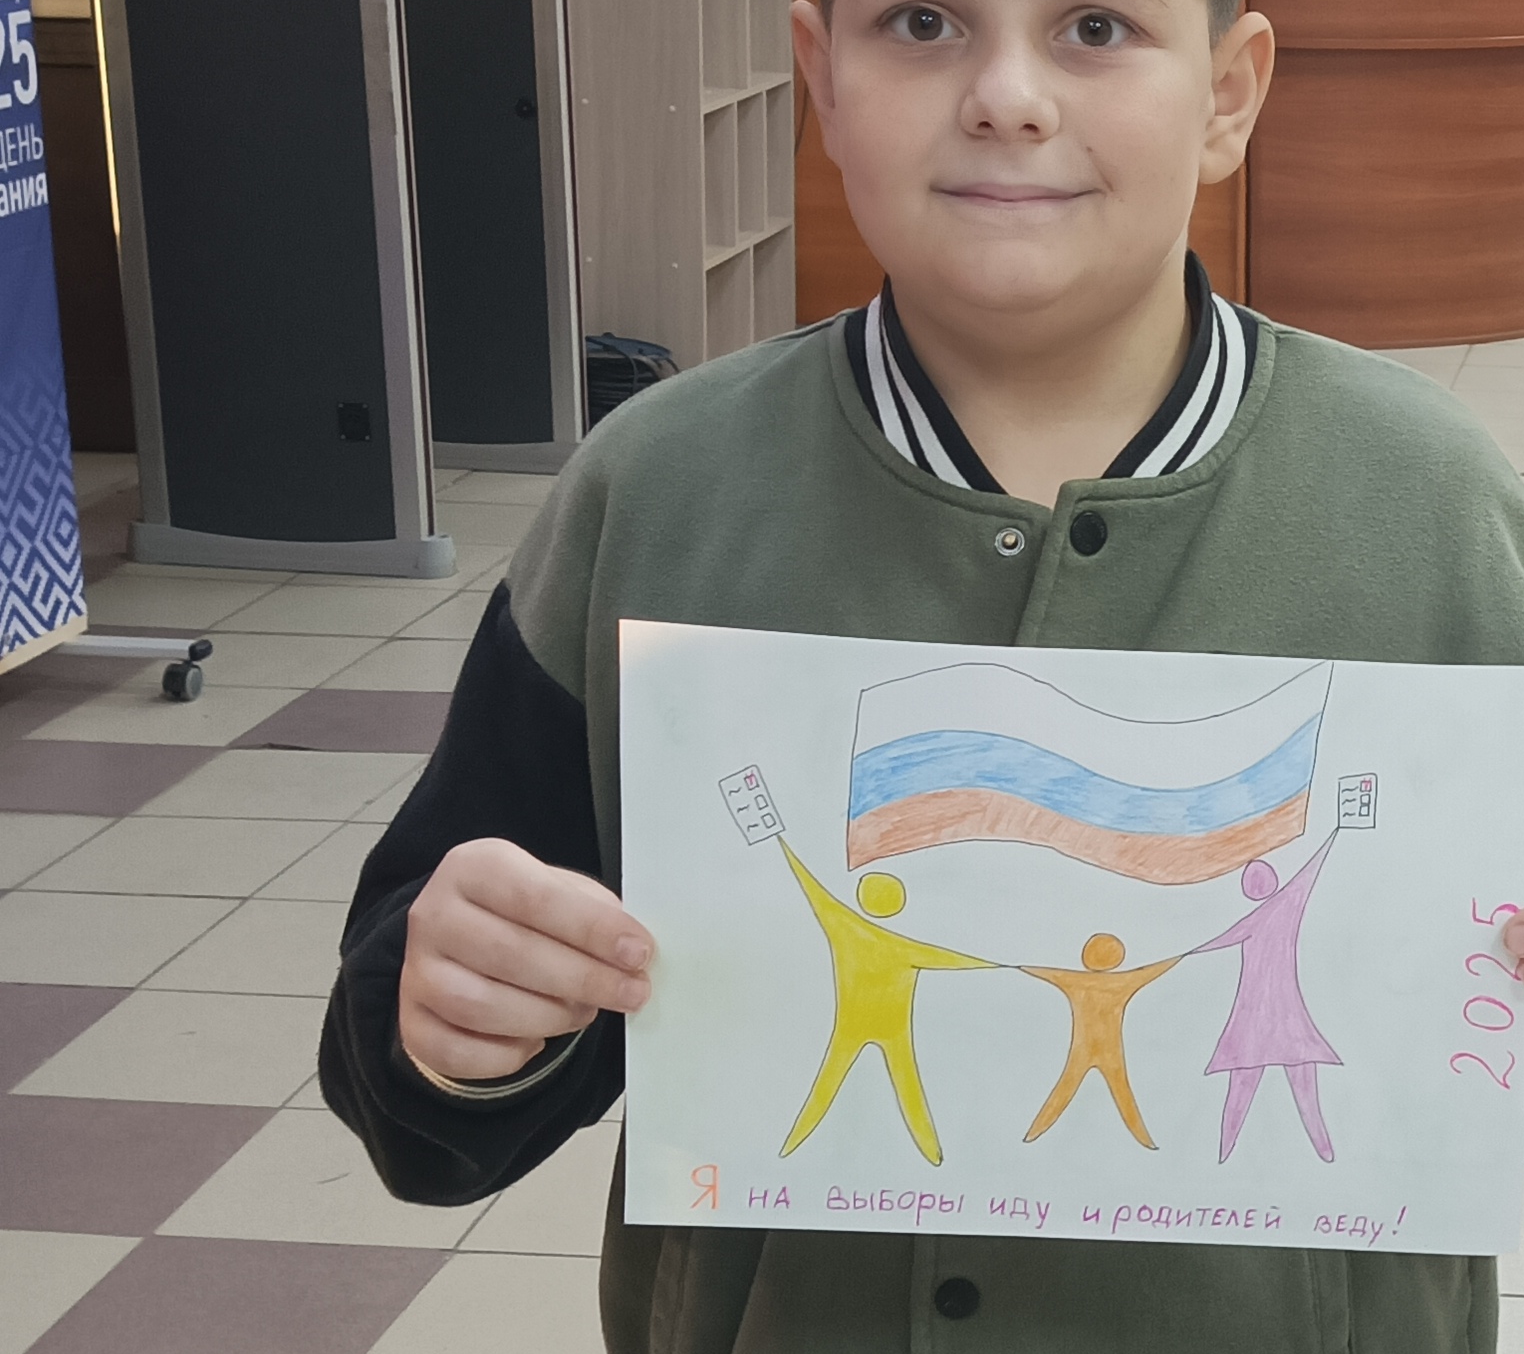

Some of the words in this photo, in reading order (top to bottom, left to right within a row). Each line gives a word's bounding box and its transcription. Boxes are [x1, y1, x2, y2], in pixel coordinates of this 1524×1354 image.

[1449, 897, 1523, 1091] 2025
[690, 1164, 719, 1210] Я
[748, 1186, 791, 1210] НА
